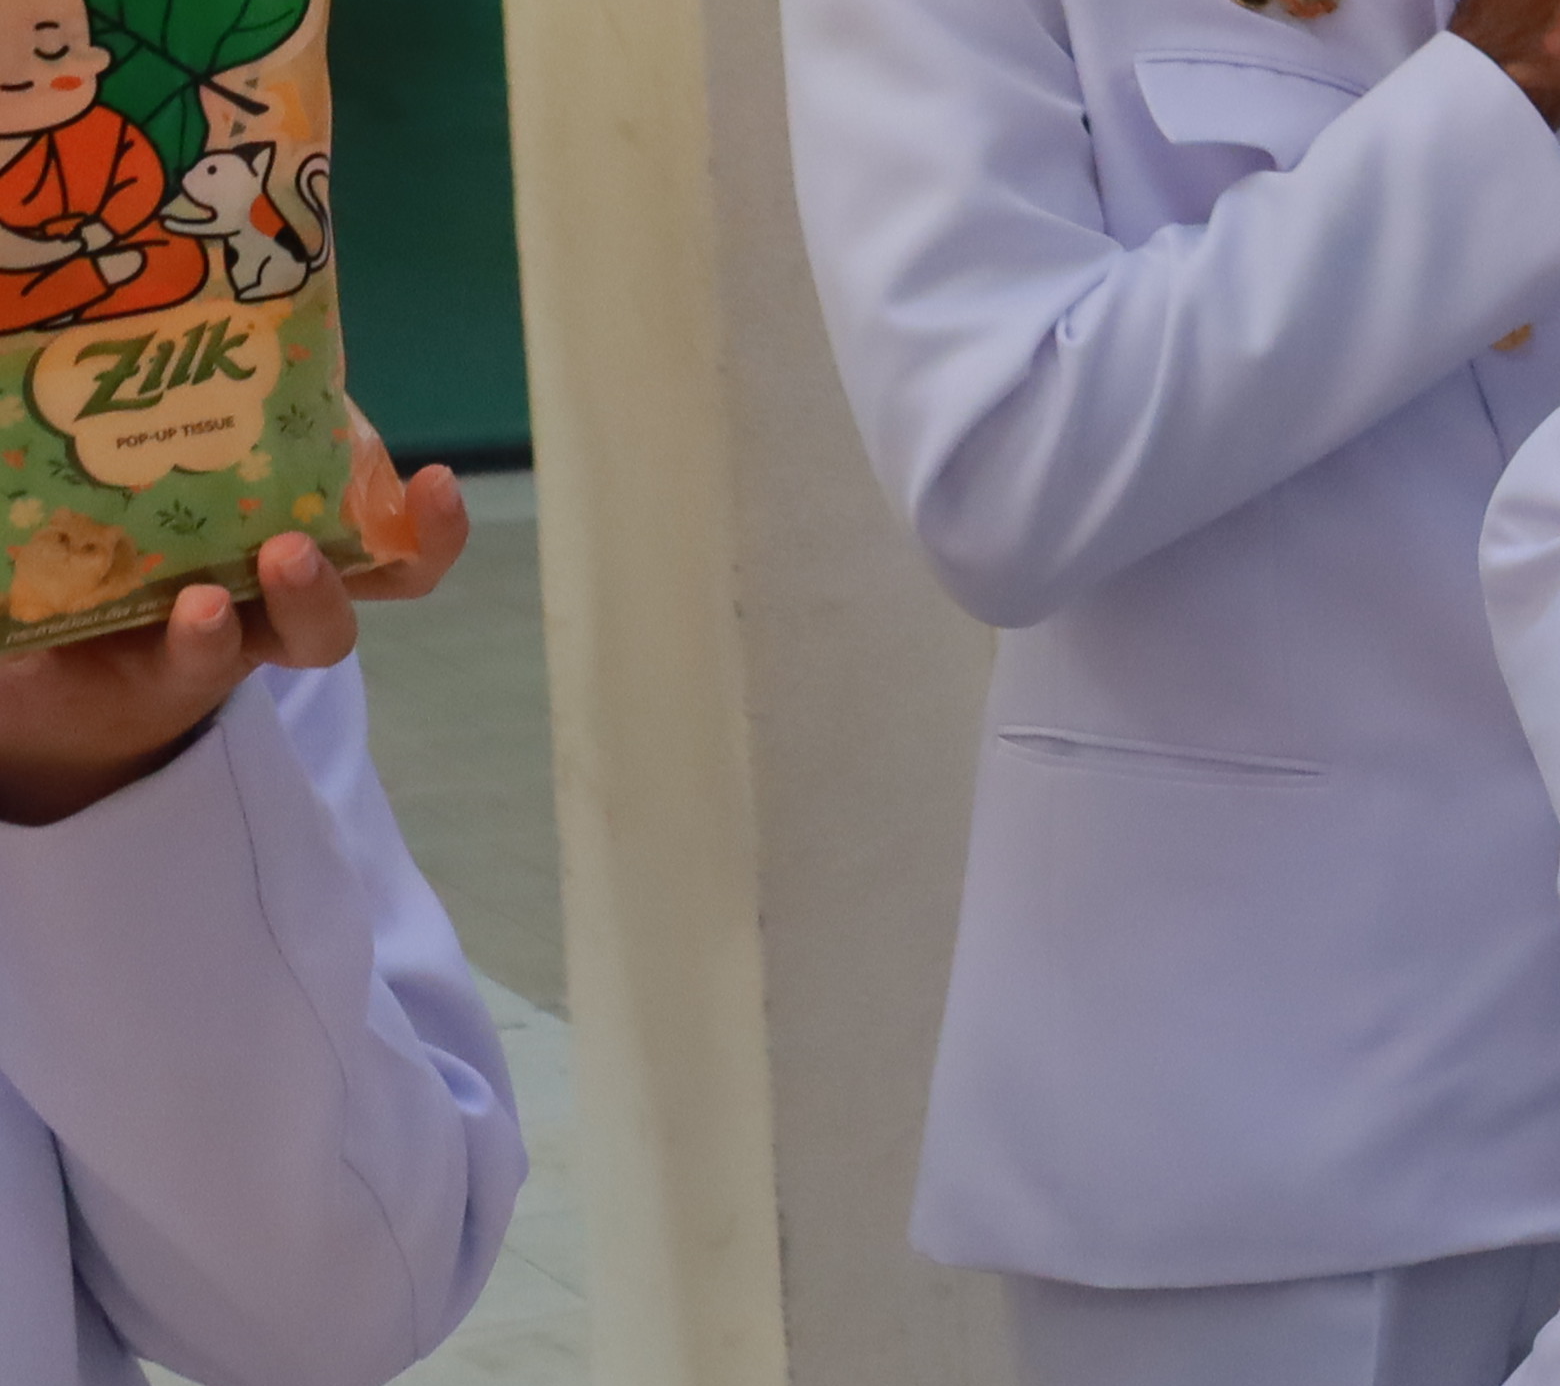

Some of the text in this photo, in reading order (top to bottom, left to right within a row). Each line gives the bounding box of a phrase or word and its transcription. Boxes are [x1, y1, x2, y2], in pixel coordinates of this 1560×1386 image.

[73, 315, 257, 423] Zilk
[116, 415, 236, 450] POP-UP TISSUE
